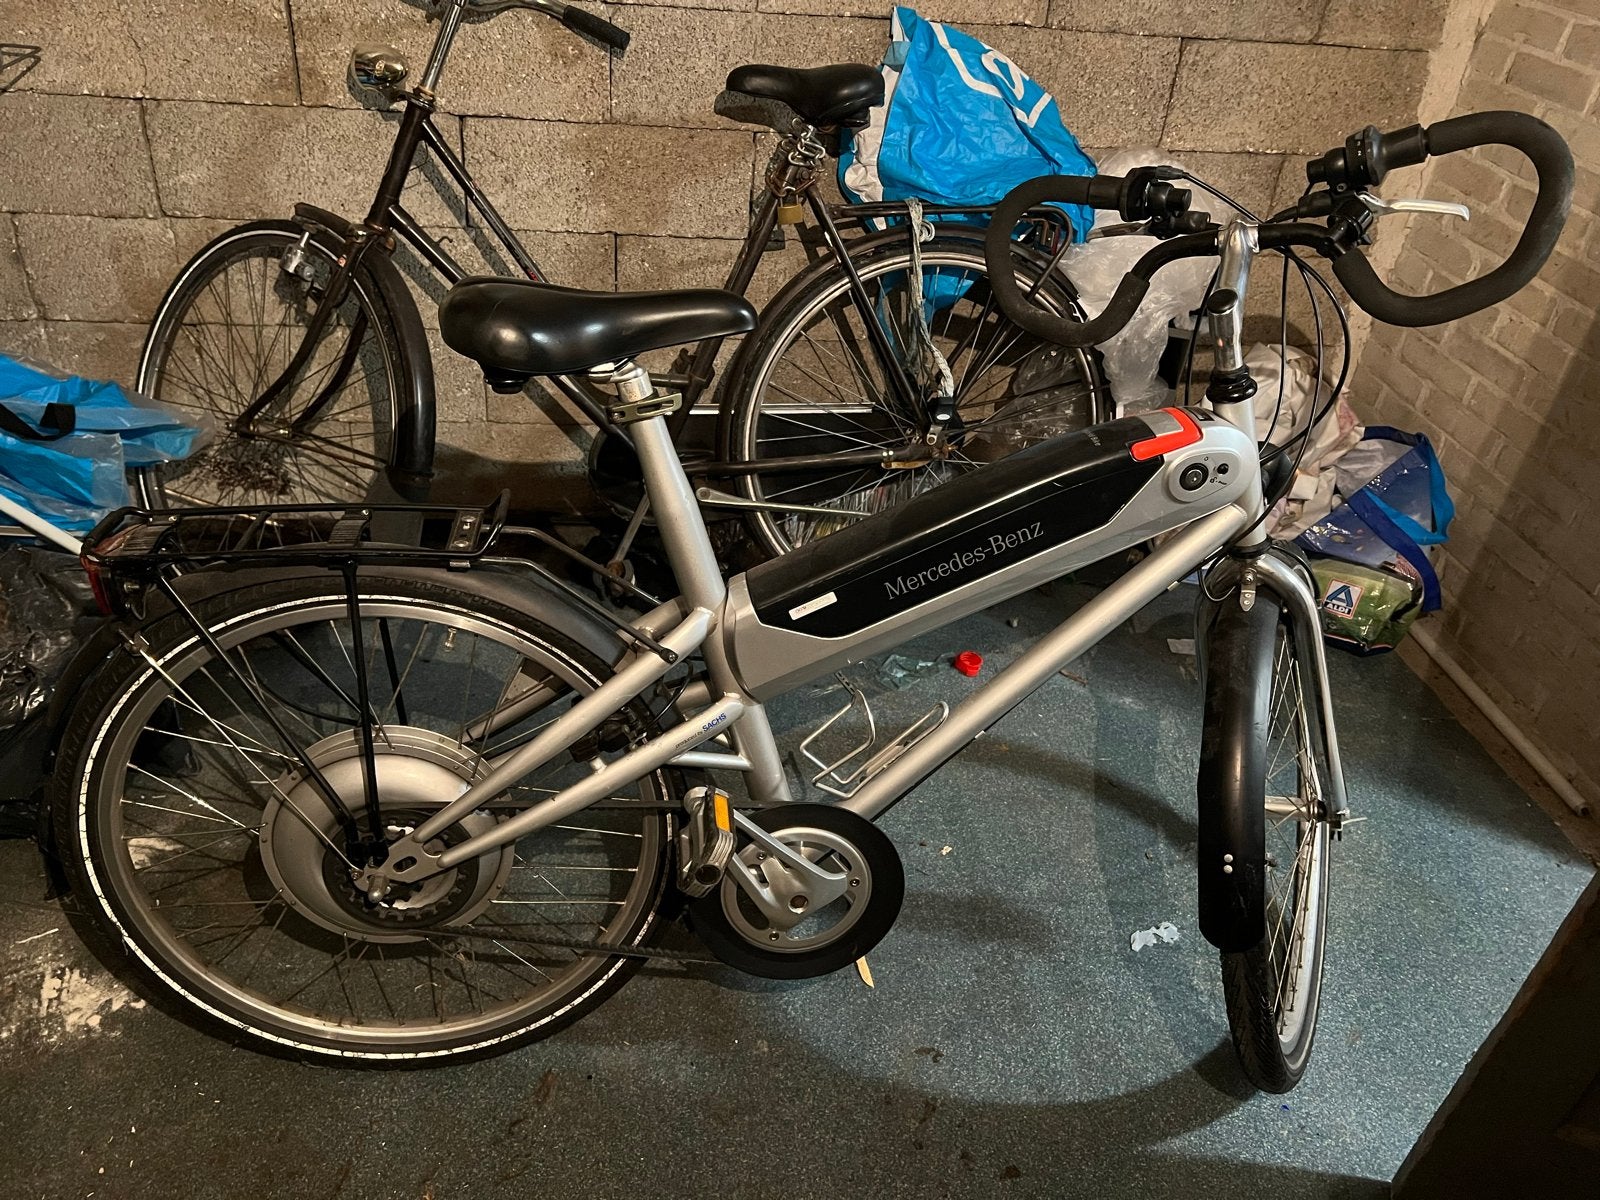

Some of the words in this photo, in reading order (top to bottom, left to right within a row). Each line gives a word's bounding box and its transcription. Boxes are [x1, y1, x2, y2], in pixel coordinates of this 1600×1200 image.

[884, 521, 1044, 600] Mercedes-Benz
[1326, 603, 1349, 614] ALDI
[702, 712, 727, 732] SACHS
